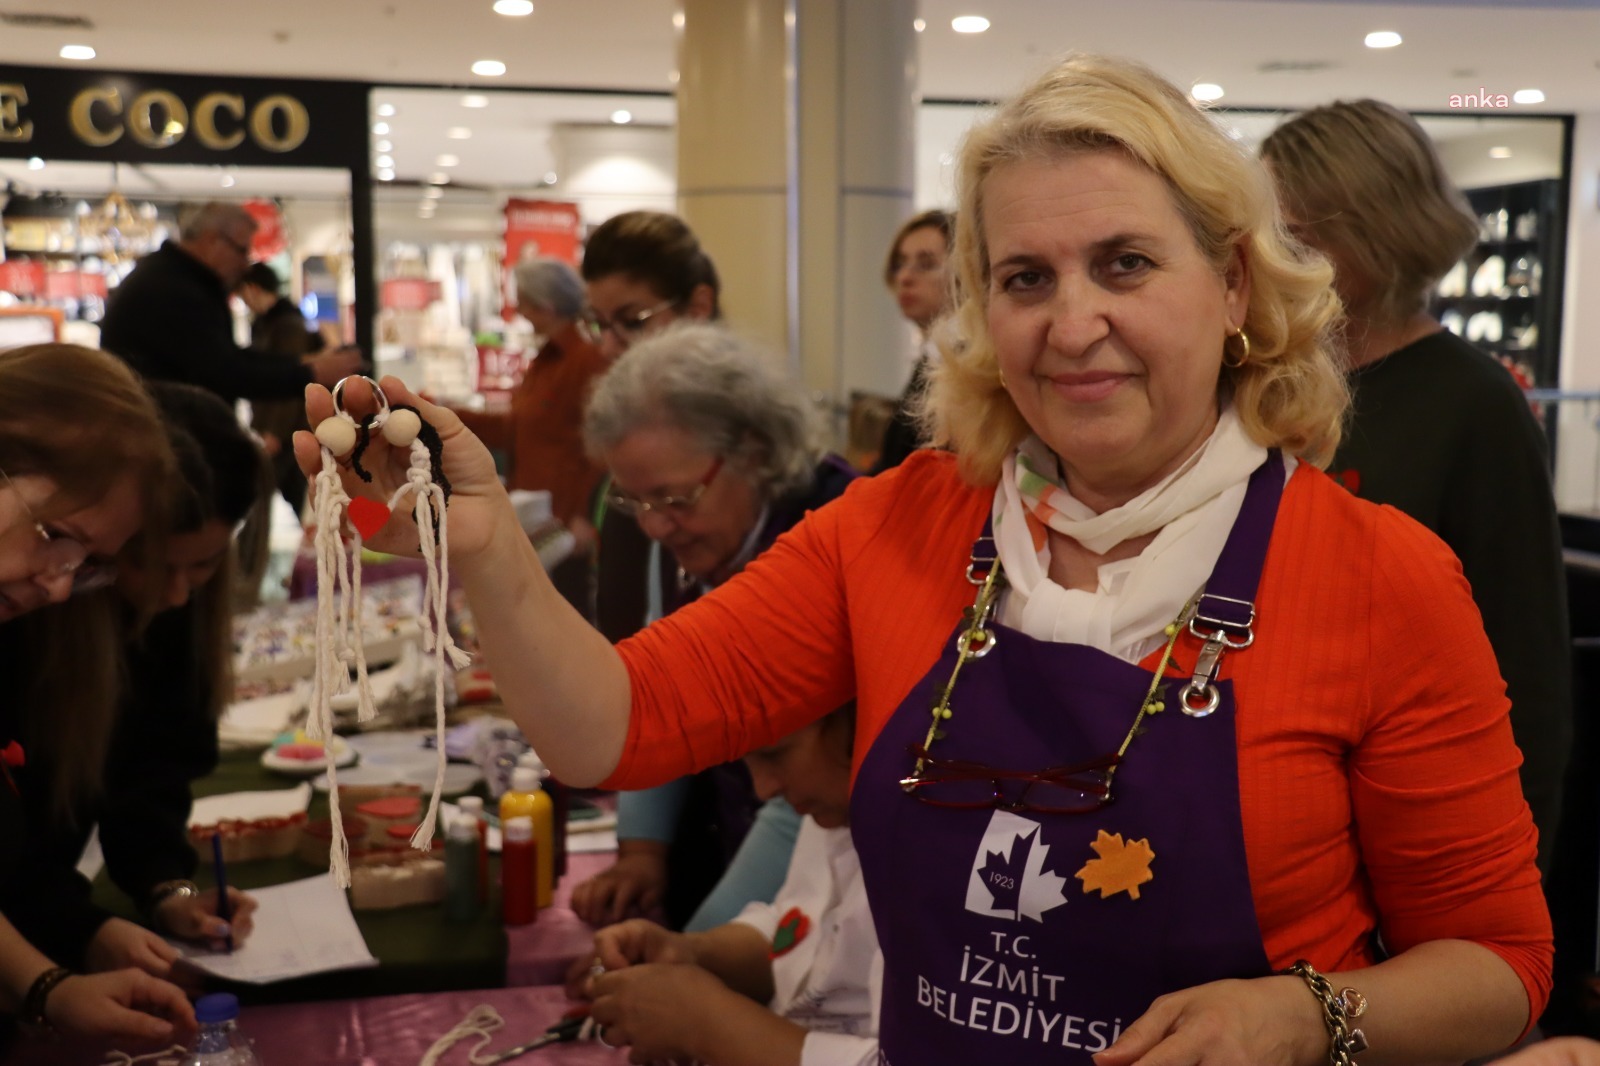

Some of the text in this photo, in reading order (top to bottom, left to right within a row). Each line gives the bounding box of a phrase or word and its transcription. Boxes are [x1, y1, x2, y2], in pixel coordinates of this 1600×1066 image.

[69, 86, 310, 152] COCO
[990, 871, 1014, 889] 1923
[960, 945, 1065, 1001] İZMİT
[991, 931, 1037, 959] T.C.
[917, 974, 1121, 1053] BELEDİYESİ
